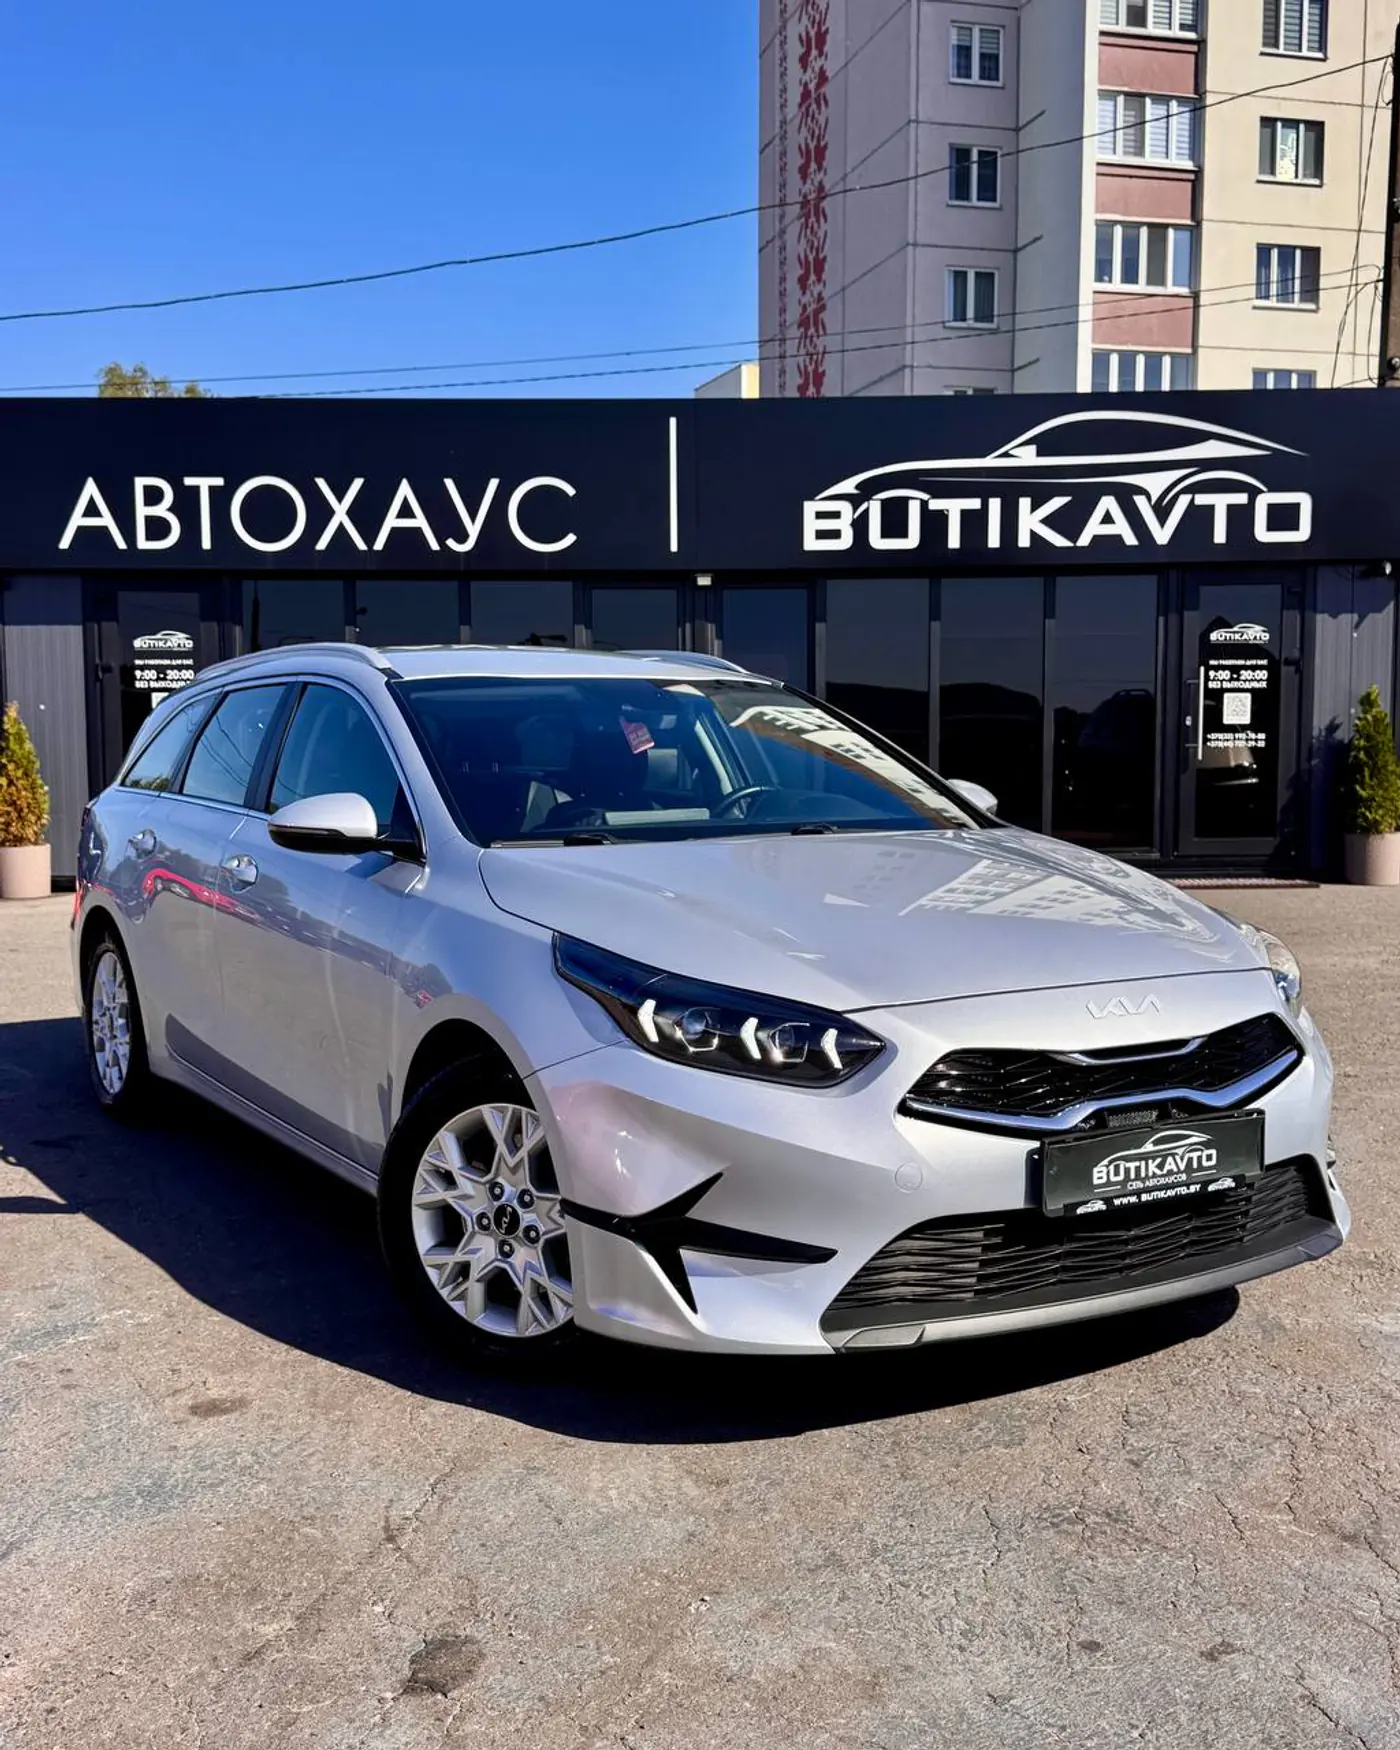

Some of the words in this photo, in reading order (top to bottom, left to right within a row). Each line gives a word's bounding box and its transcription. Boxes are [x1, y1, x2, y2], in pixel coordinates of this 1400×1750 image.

[58, 475, 577, 552] АВТОХАУС
[802, 491, 1313, 551] BUTIKAVTO
[1209, 632, 1270, 641] BUTIKAVTO
[134, 669, 157, 680] 9:00
[166, 669, 195, 680] 20:00
[1208, 669, 1231, 680] 9:00
[1239, 669, 1268, 680] 20:00
[1092, 1149, 1217, 1185] BUTIKAVTO
[1140, 1184, 1201, 1202] BUTIKAVTO.BY
